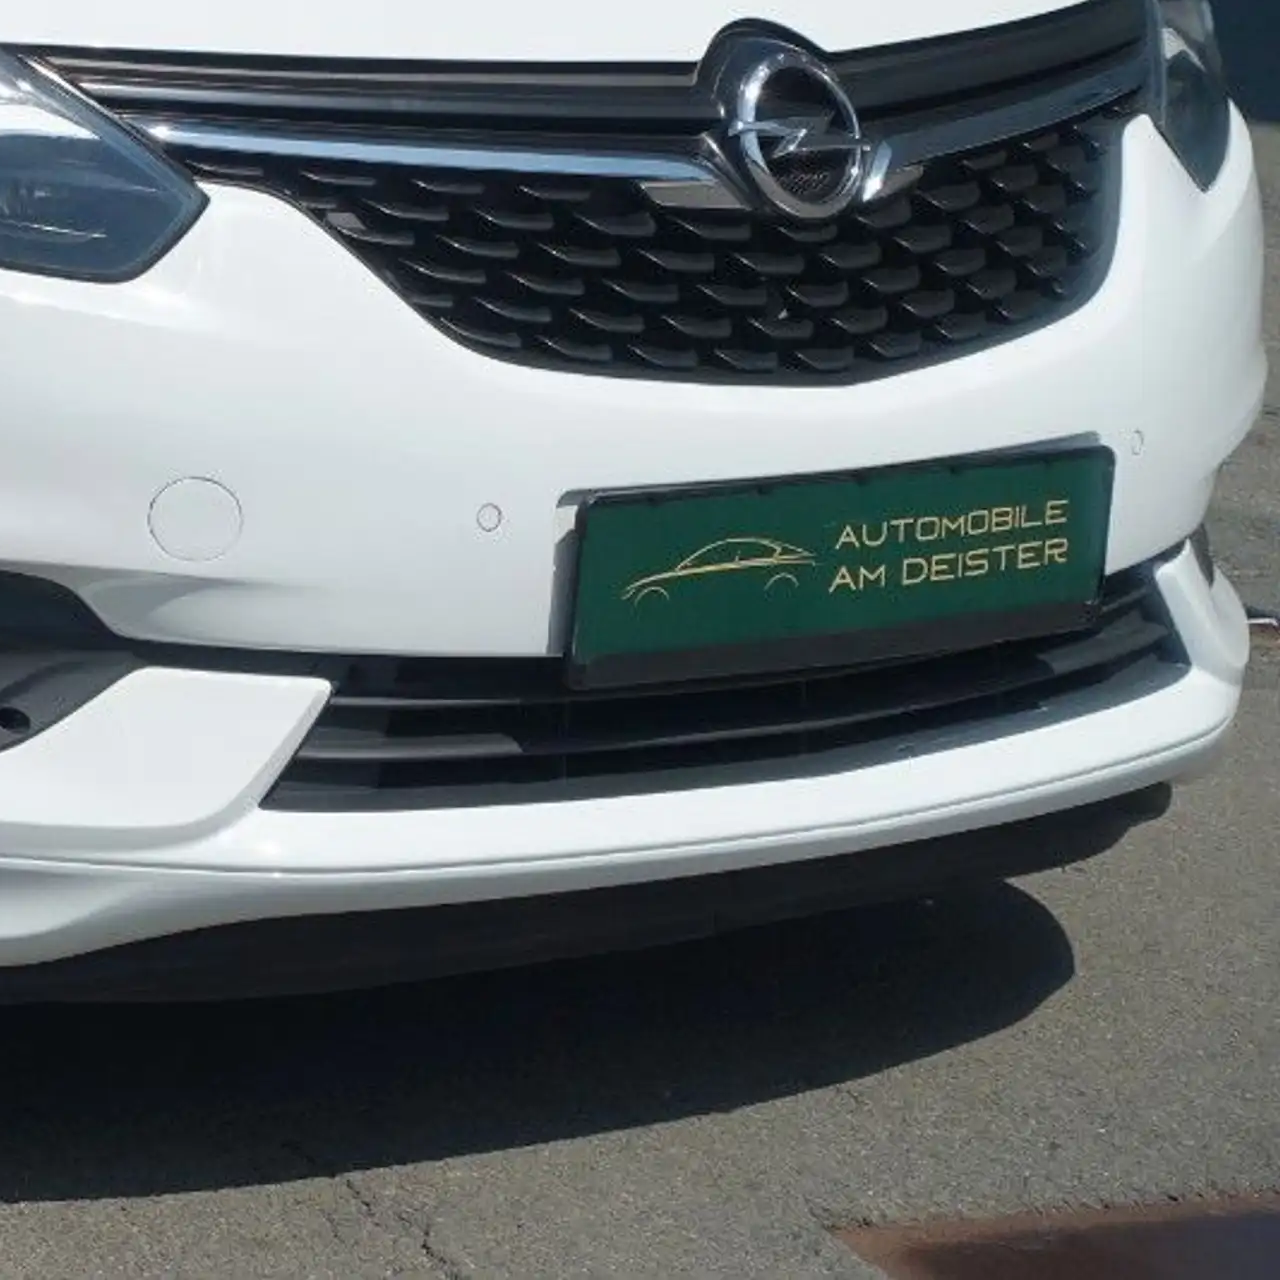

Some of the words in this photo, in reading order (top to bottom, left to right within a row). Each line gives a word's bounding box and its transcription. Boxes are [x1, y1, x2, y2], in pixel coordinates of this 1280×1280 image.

[835, 499, 1069, 550] AUTOMOBILE
[828, 564, 887, 593] AM
[902, 537, 1069, 586] DEISTER
